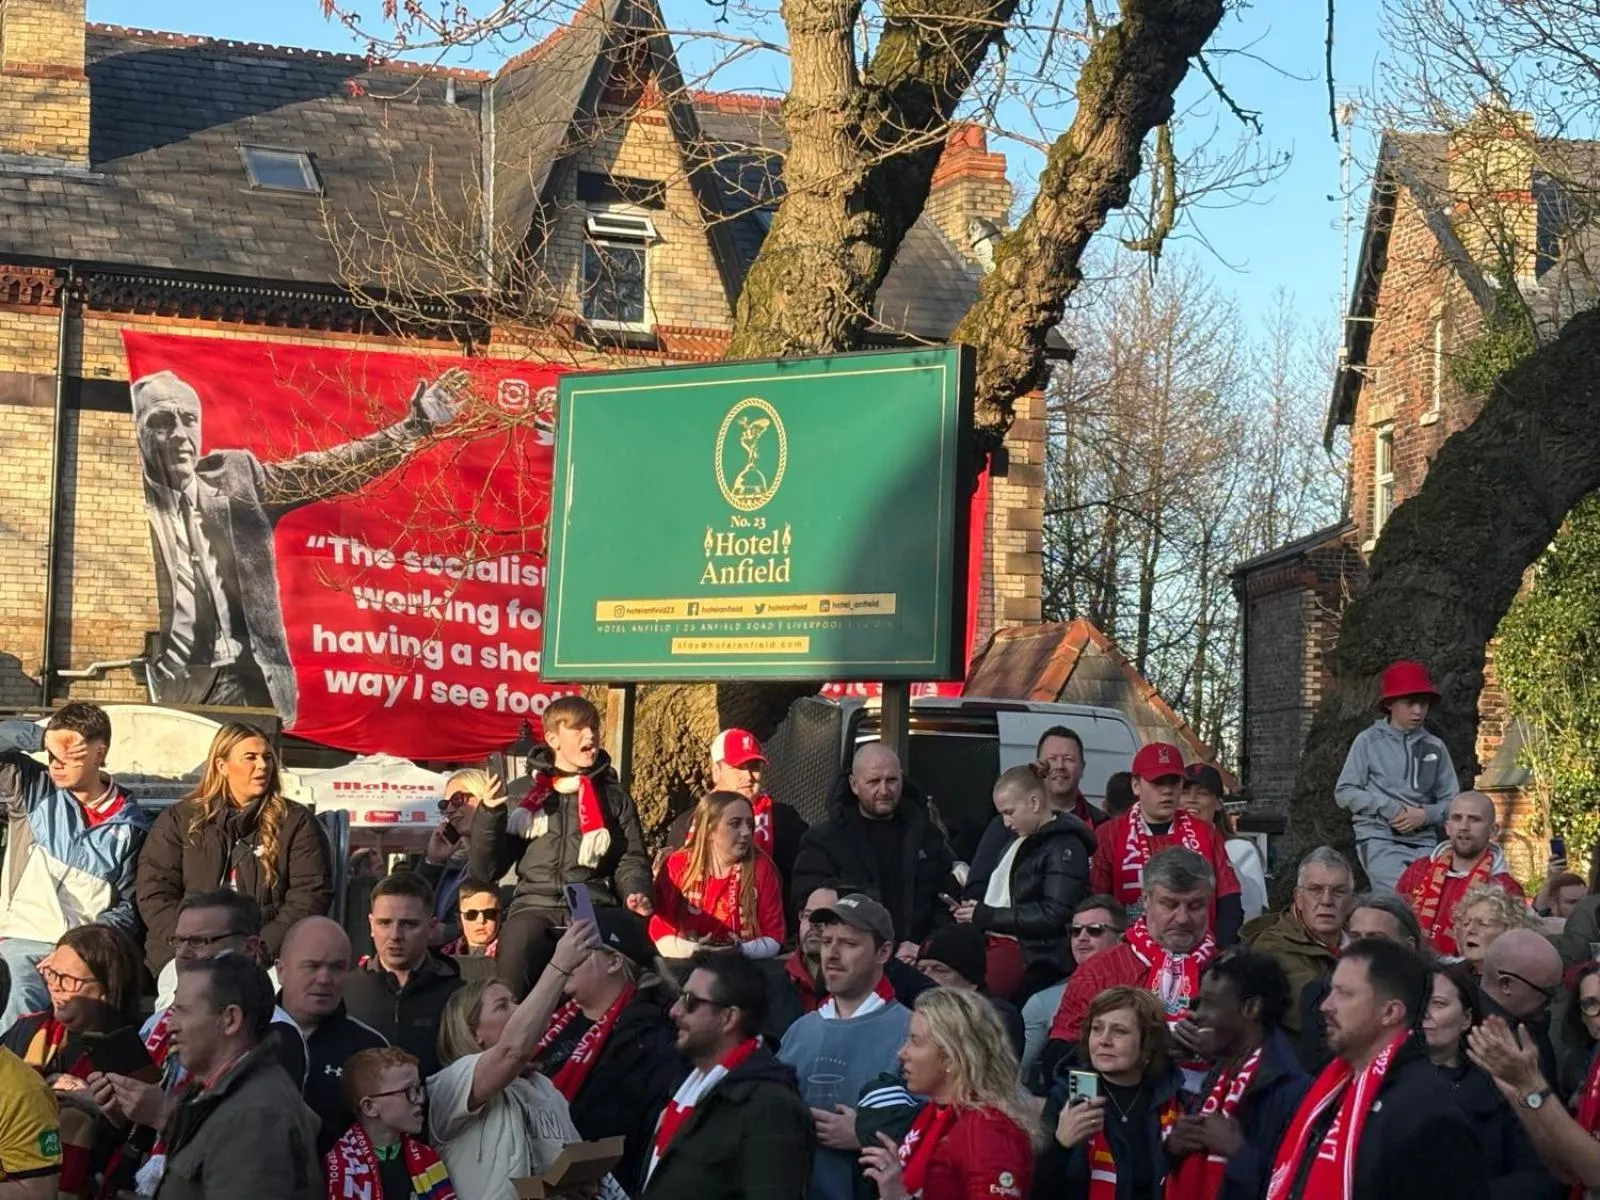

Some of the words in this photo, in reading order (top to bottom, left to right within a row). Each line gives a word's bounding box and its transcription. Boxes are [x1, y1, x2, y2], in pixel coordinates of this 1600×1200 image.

[730, 515, 751, 528] No.
[753, 517, 767, 530] 23
[715, 529, 779, 556] Hotel
[403, 549, 546, 588] socialis
[700, 557, 790, 585] Anfield
[352, 586, 499, 636] working
[507, 599, 542, 630] fo
[312, 624, 443, 670] having
[451, 643, 472, 667] a
[481, 642, 541, 673] sha
[324, 669, 408, 708] way
[413, 674, 424, 700] I
[431, 680, 489, 709] see
